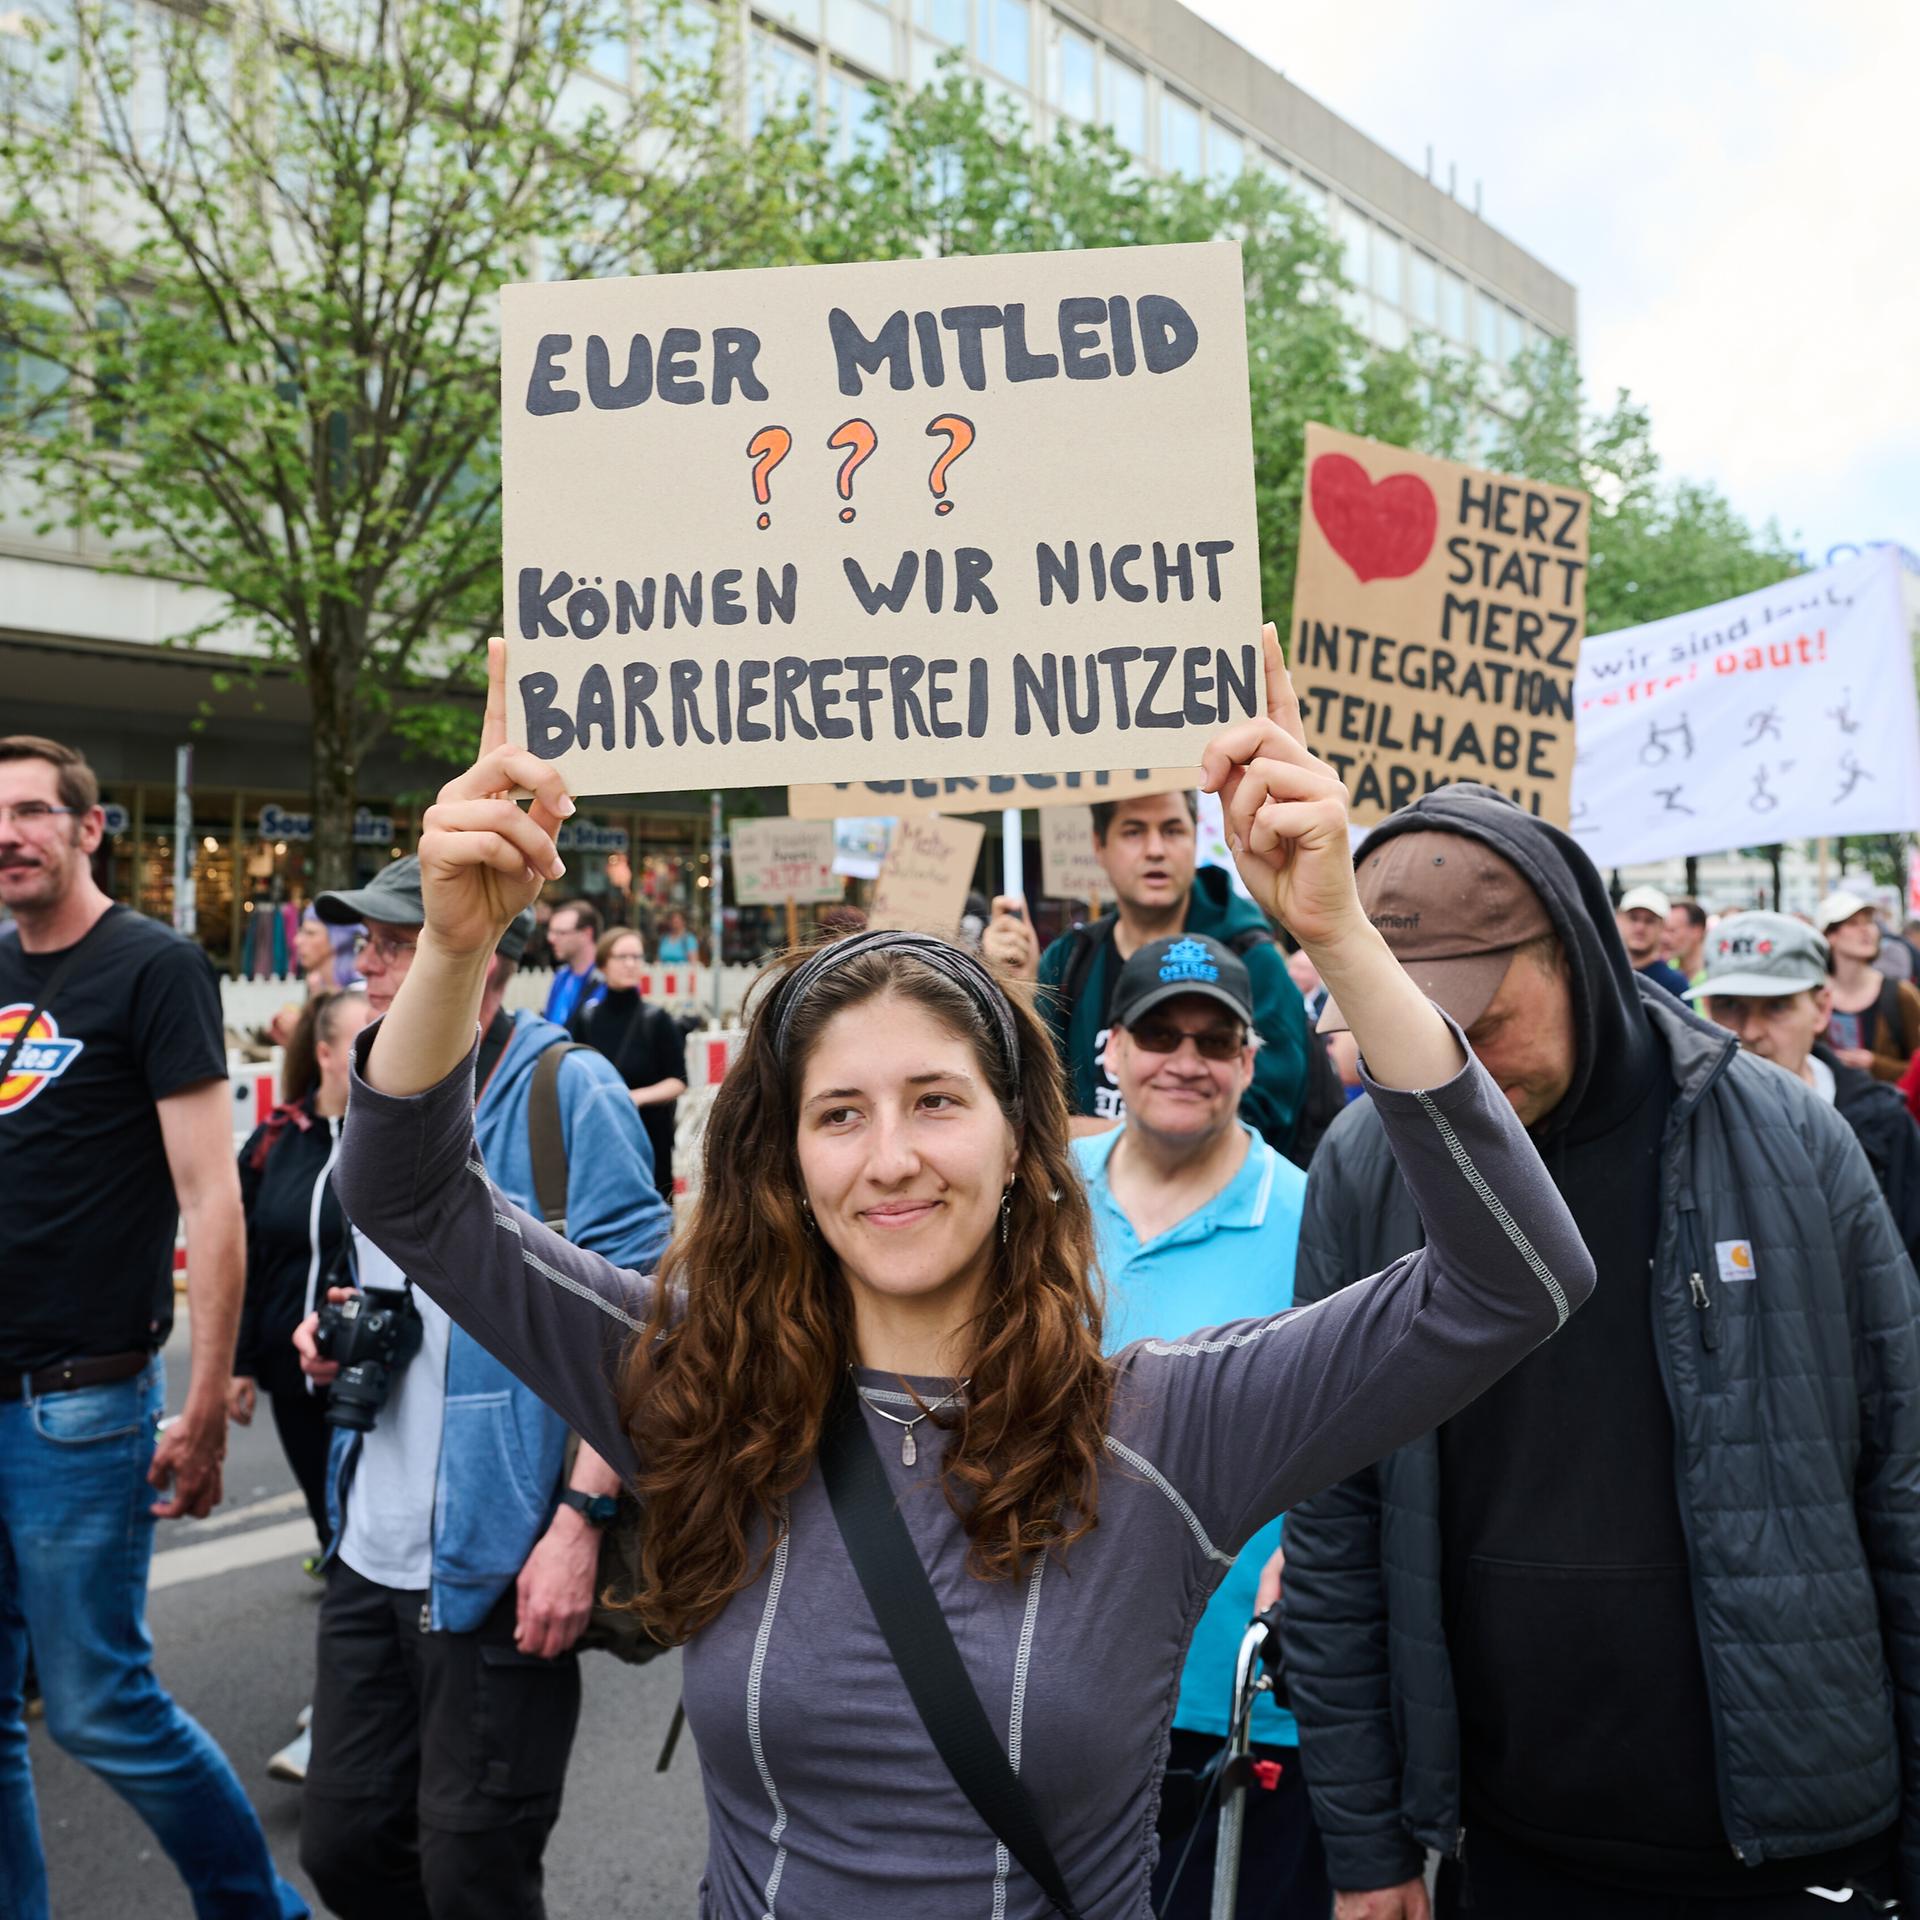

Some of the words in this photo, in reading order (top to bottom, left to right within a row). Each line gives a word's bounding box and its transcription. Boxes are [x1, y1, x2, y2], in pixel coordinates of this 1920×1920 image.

[527, 328, 769, 416] EUER
[829, 294, 1199, 397] MITLEID
[746, 425, 792, 530] ?
[827, 418, 878, 523] ?
[926, 413, 976, 517] ?
[1458, 477, 1582, 550] HERZ
[518, 561, 798, 640] KÖNNEN
[843, 547, 999, 616] WIR
[1036, 540, 1235, 607] NICHT
[1447, 536, 1584, 607] STATT
[1297, 620, 1575, 722] INTEGRATION
[1441, 591, 1578, 670] MERZ
[1591, 648, 1653, 680] wir
[1670, 618, 1750, 664] sind
[518, 655, 987, 760] BARRIEREFREI
[1013, 644, 1257, 738] NUTZEN
